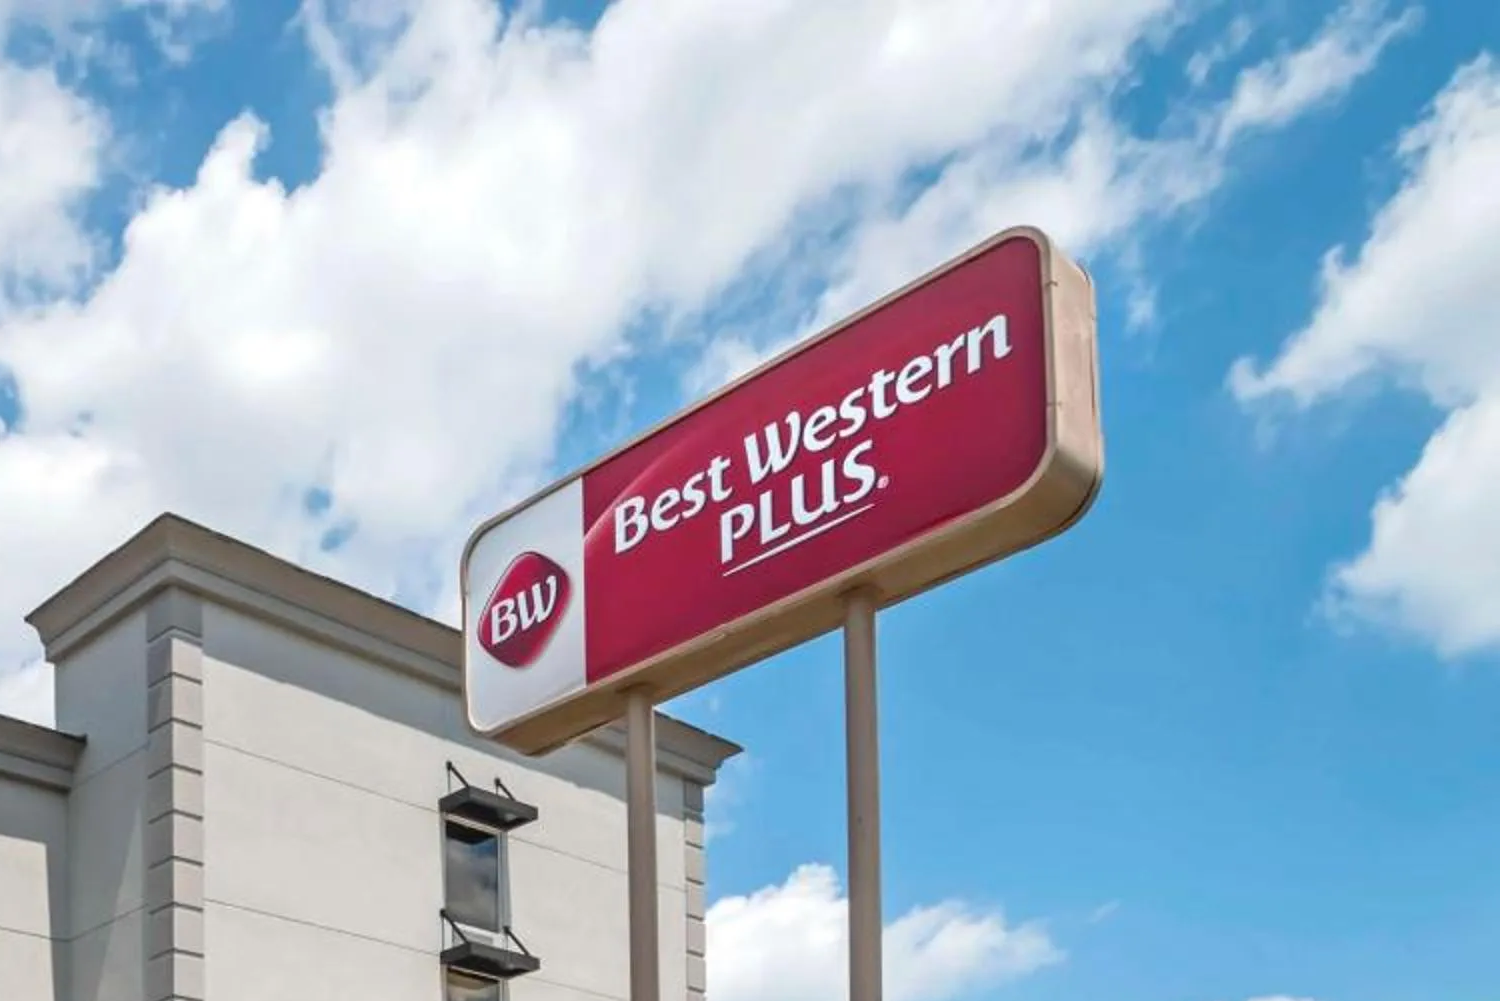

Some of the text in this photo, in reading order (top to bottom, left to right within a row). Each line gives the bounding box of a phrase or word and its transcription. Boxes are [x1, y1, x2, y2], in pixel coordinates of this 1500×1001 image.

[613, 314, 1012, 554] Best Western
[491, 575, 557, 645] BW
